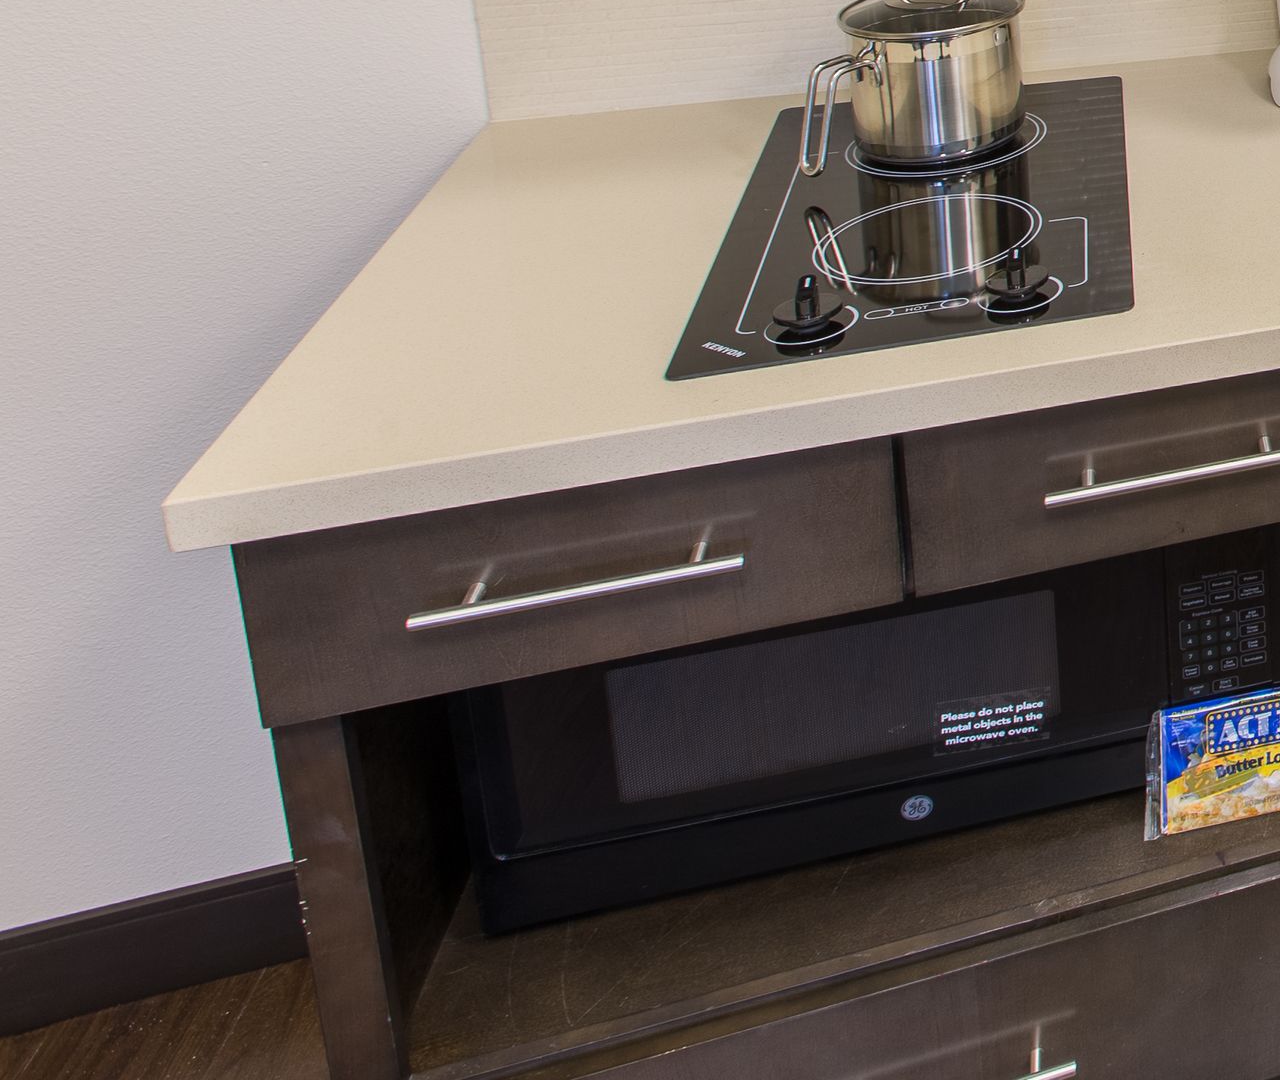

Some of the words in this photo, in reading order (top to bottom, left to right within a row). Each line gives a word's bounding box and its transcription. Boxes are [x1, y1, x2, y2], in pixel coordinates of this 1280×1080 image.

[905, 304, 928, 312] HOT
[702, 341, 746, 358] KENYON
[941, 711, 976, 722] Please
[978, 708, 993, 717] do
[995, 705, 1014, 714] not
[1016, 700, 1044, 714] place
[941, 722, 972, 734] metal
[974, 717, 1012, 730] objects
[1014, 715, 1023, 723] in
[1025, 712, 1043, 721] the
[1218, 710, 1272, 744] ACT
[945, 730, 1006, 746] microwave
[1008, 726, 1038, 736] oven.
[1214, 754, 1264, 780] Butter
